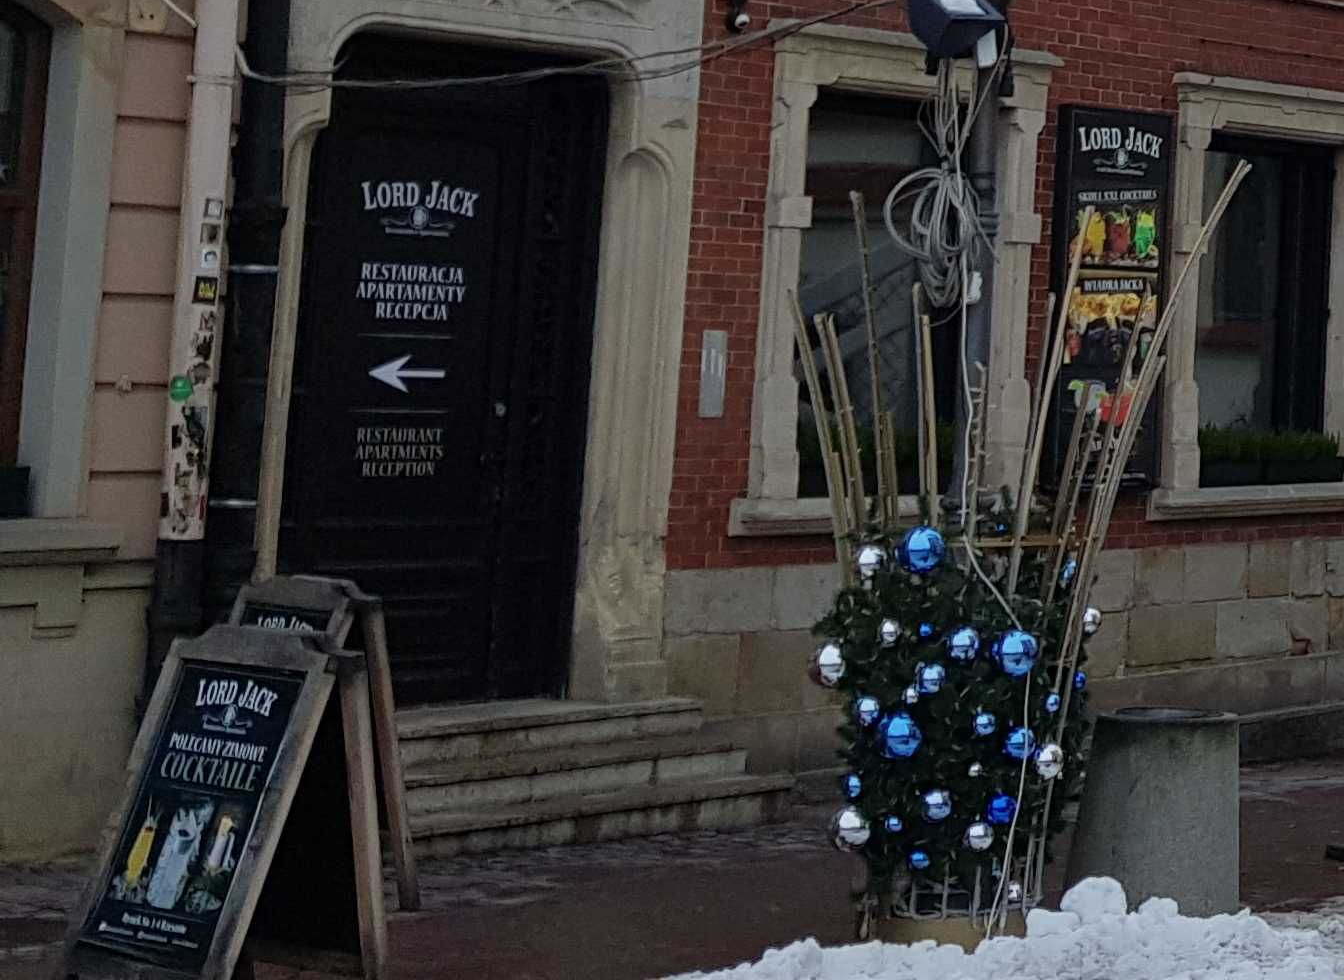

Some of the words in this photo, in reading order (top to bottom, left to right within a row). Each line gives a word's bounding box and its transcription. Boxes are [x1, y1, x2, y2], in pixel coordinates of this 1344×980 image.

[1078, 126, 1121, 152] LORD
[1124, 126, 1163, 158] JACK
[361, 181, 419, 210] LORD
[425, 181, 479, 218] JACK
[361, 262, 463, 283] RESTAURACJA
[356, 281, 466, 303] APARTAMENTY
[376, 302, 448, 321] RECEPCJA
[357, 428, 443, 443] RESTAURANT
[355, 444, 444, 460] APARTMENTS
[362, 461, 435, 477] RECEPTION
[196, 678, 238, 707] LORD
[238, 679, 278, 717] JACK
[169, 731, 224, 755] POLECAMY
[222, 740, 268, 763] ZIMOWE
[160, 752, 262, 792] COCKTAILE
